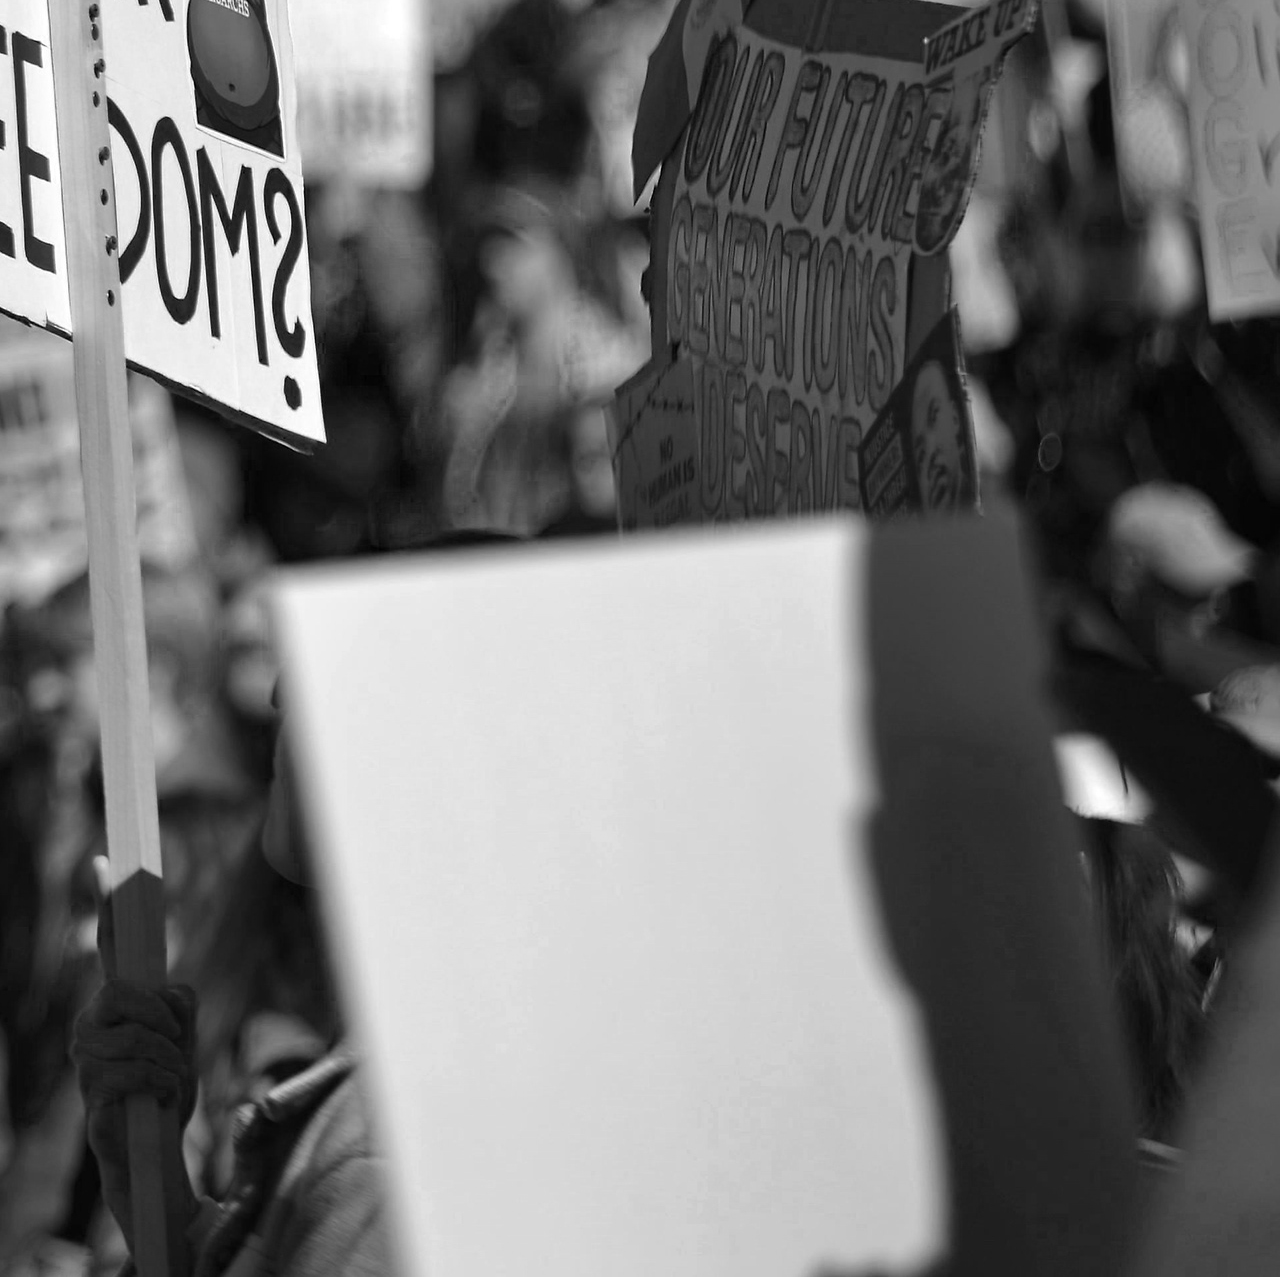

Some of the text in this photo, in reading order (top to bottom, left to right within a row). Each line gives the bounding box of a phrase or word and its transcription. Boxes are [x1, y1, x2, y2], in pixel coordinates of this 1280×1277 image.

[925, 8, 989, 75] WAKE
[684, 29, 954, 245] OUR FUTURE
[667, 191, 897, 413] GENERATIONS
[660, 435, 673, 465] NO
[699, 358, 862, 520] DESERVE
